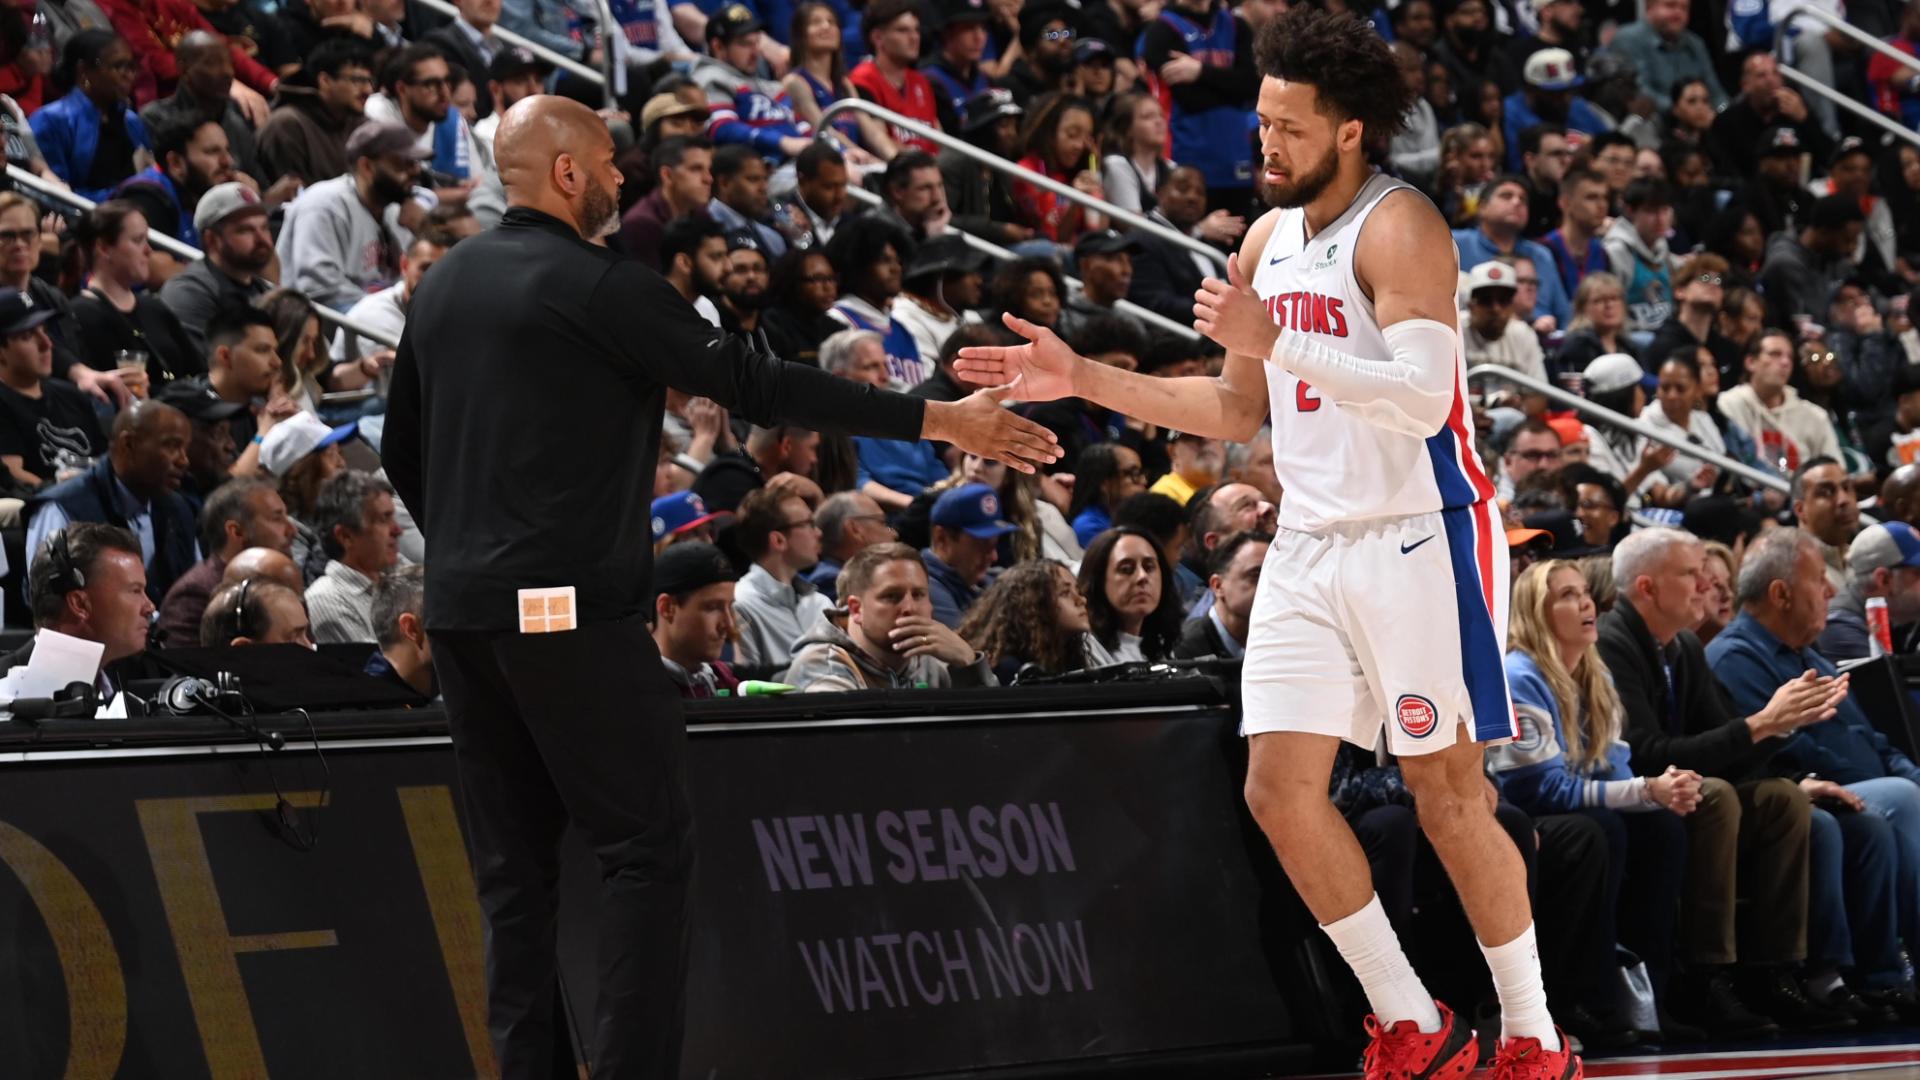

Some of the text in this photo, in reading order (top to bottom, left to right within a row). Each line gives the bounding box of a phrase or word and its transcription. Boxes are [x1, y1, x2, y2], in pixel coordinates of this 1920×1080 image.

[1401, 706, 1427, 717] DETROIT
[1403, 713, 1430, 724] PISTONS
[752, 801, 1078, 892] NEW SEASON
[797, 919, 1094, 1014] WATCH NOW
